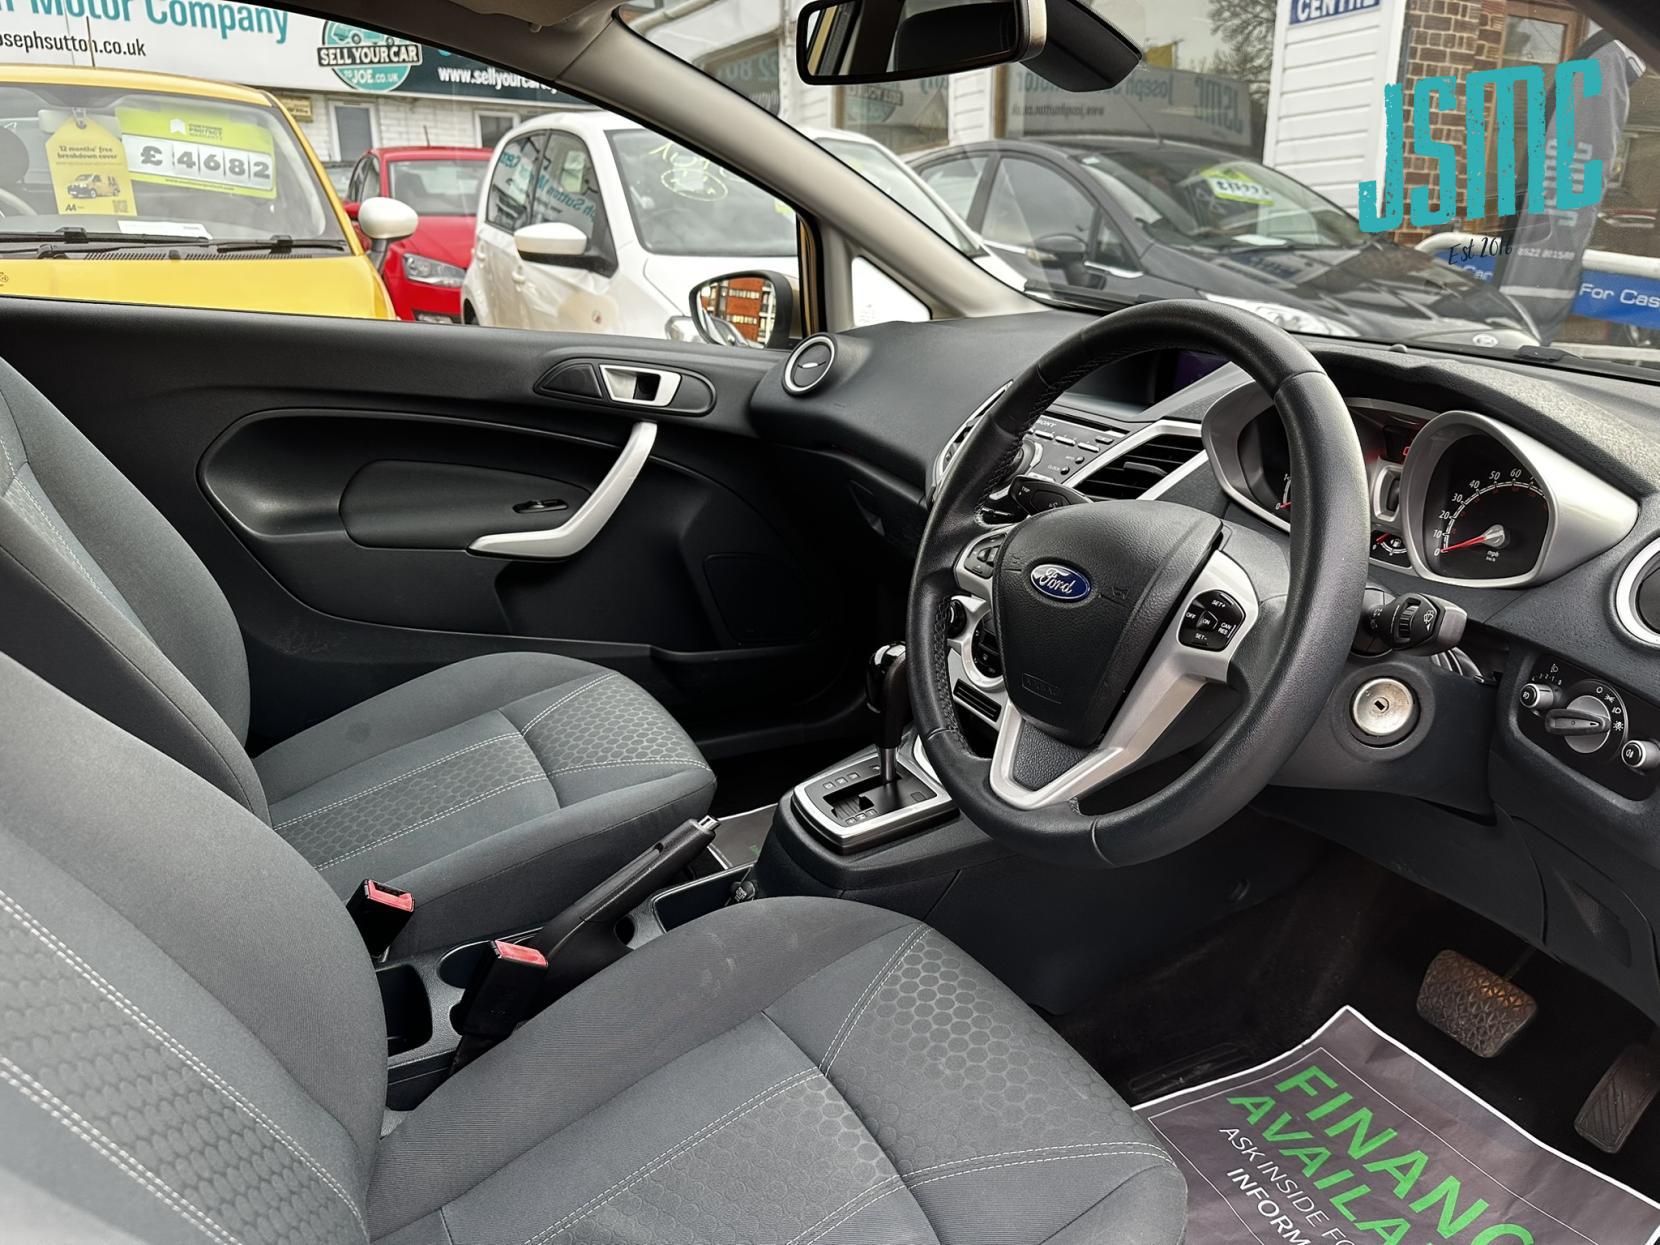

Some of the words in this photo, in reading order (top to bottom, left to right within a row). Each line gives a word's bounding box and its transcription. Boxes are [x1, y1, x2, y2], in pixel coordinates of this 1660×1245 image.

[145, 0, 288, 44] Company
[320, 47, 352, 65] SELL
[352, 46, 389, 63] YOUR
[390, 45, 418, 62] CAR
[1579, 282, 1615, 299] For
[1489, 470, 1501, 480] 50
[1510, 468, 1521, 478] 60
[1469, 480, 1480, 489] 40
[1452, 493, 1463, 503] 30
[1439, 510, 1450, 519] 20
[1433, 530, 1442, 538] 10
[1226, 1096, 1412, 1245] AVAILA
[1219, 1127, 1265, 1161] ASK
[1256, 1161, 1330, 1228] INSIDE
